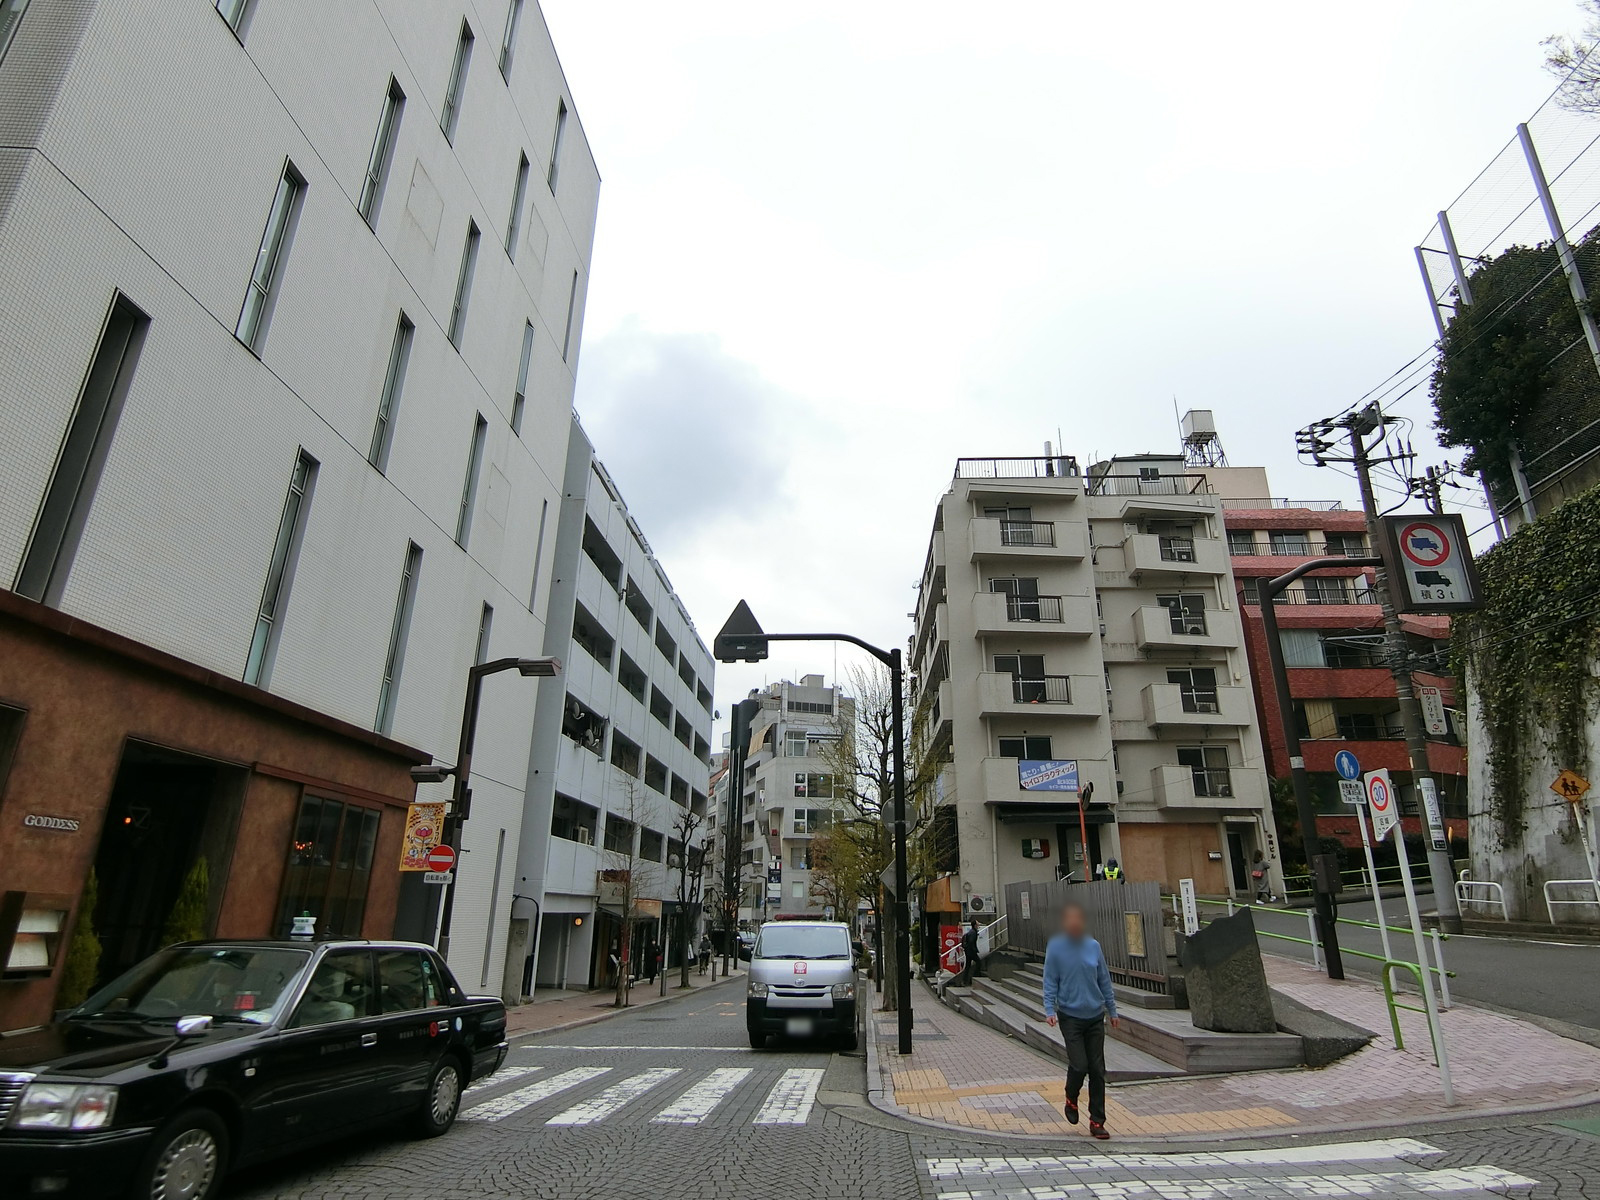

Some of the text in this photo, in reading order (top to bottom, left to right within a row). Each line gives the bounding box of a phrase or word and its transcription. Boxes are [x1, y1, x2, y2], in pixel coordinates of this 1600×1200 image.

[1023, 763, 1075, 787] カイロプラクティック
[1373, 785, 1385, 802] 30
[24, 814, 80, 831] GODDESS
